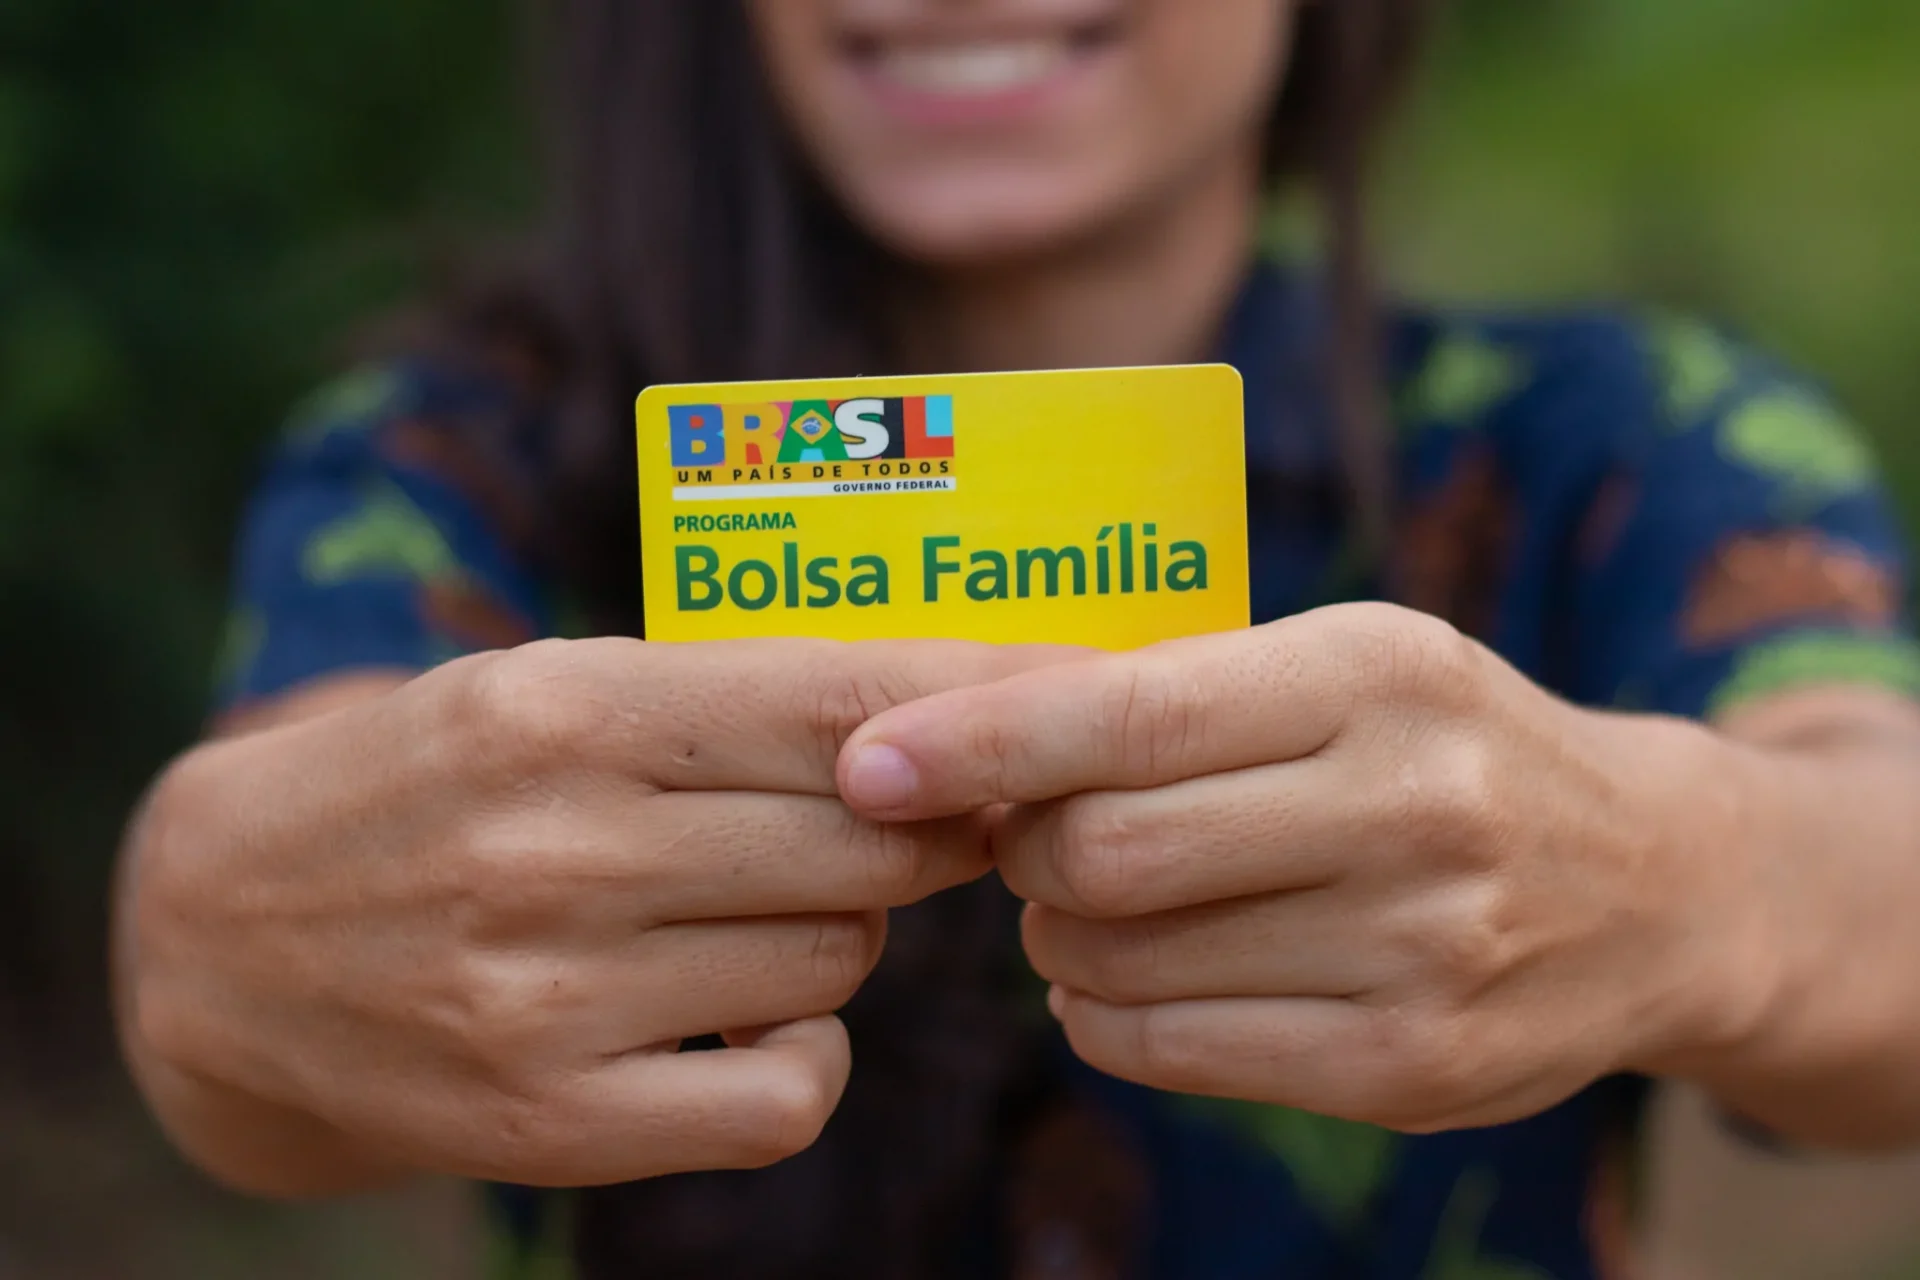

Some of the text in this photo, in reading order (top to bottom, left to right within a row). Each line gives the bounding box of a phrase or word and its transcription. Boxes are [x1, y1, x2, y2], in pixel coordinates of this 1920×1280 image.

[667, 395, 954, 467] BRASIL
[677, 461, 949, 483] UM PAÍS DE TODOS
[833, 479, 949, 493] GOVERNO FEDERAL
[674, 512, 797, 532] PROGRAMA
[674, 522, 1208, 612] Bolsa Família
